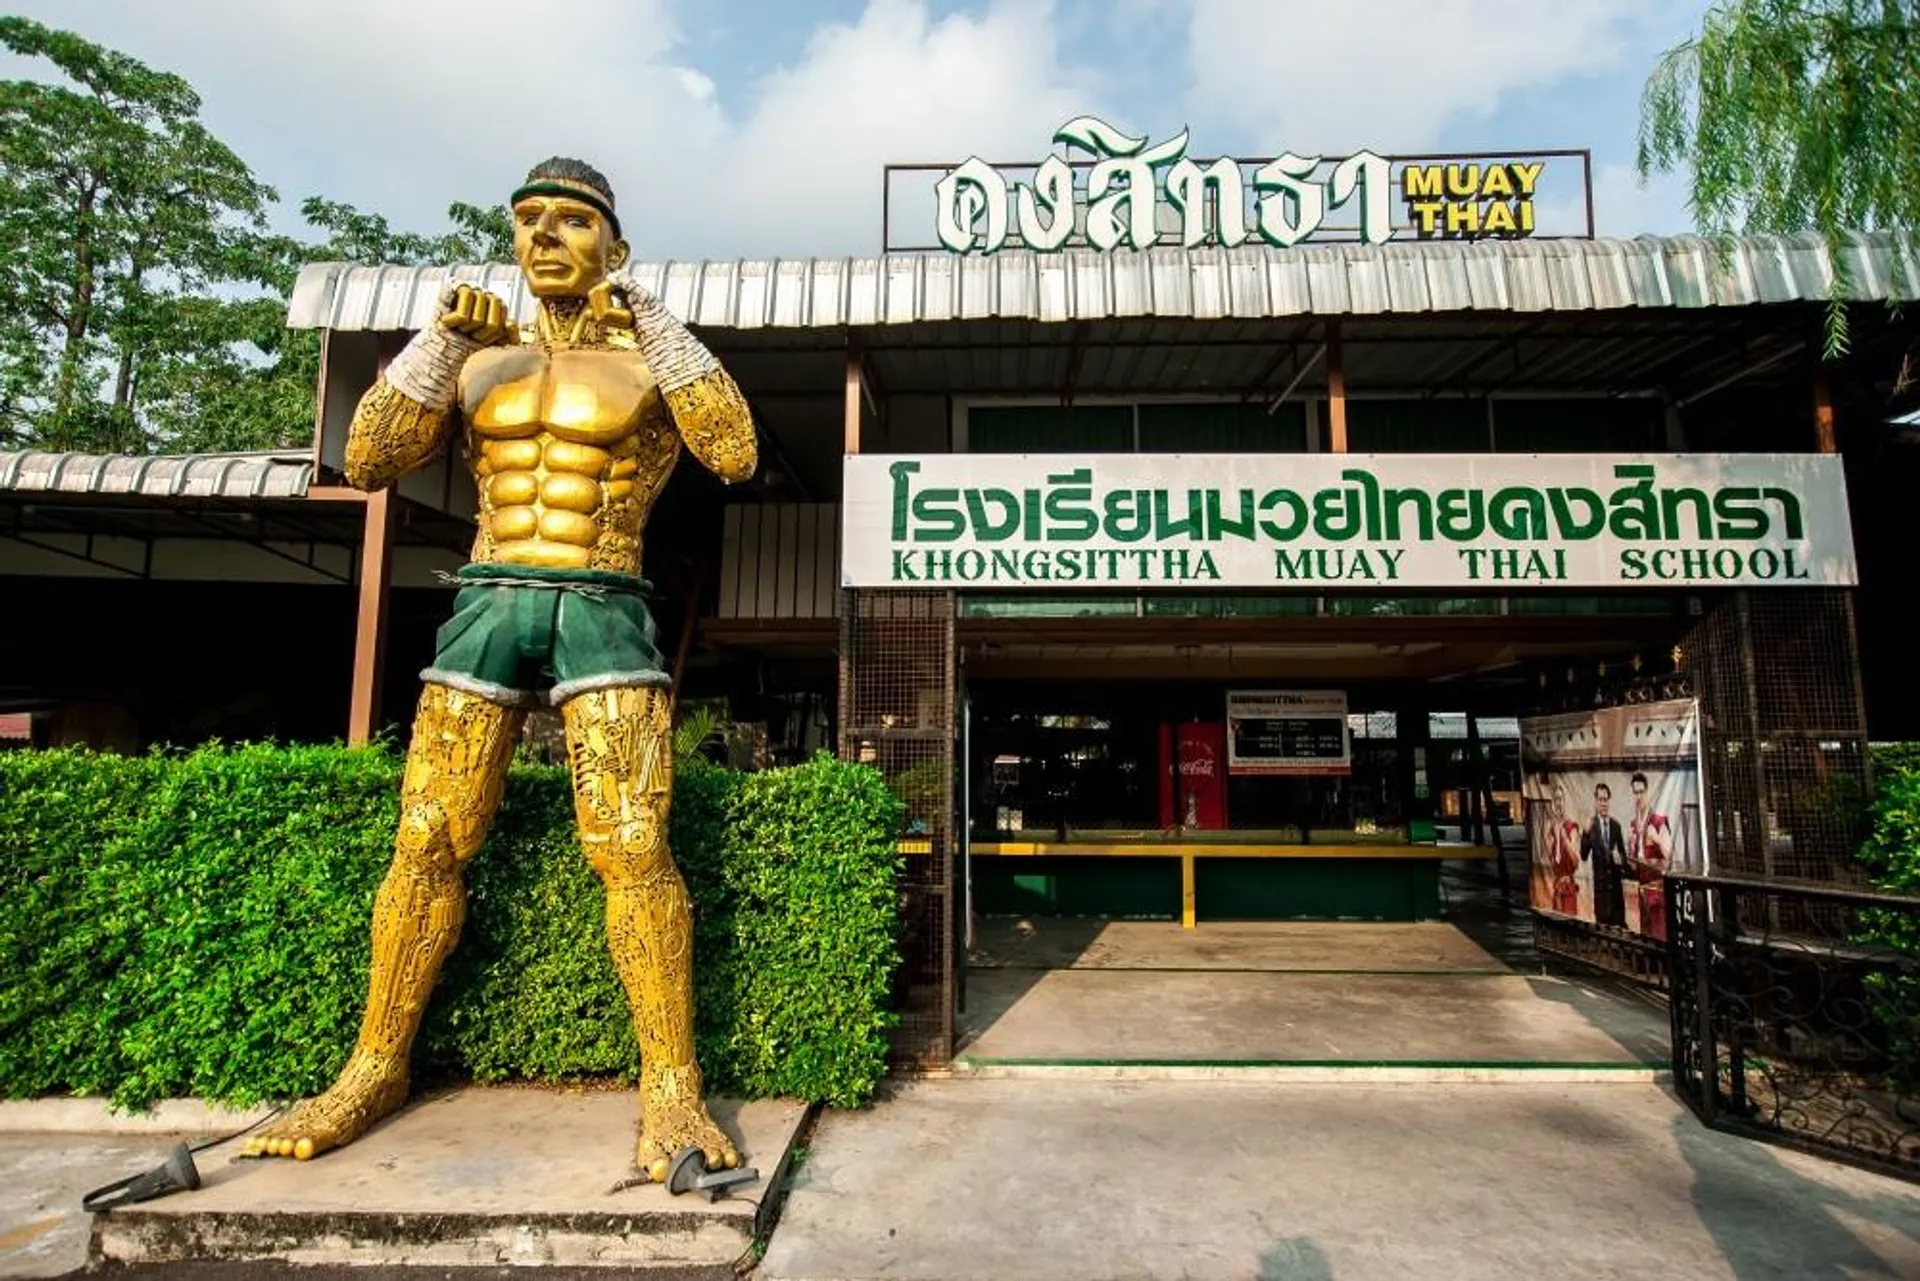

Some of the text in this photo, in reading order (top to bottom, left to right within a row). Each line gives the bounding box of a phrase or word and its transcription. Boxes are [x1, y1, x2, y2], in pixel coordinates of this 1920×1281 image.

[935, 115, 1396, 256] คงสิทธา
[1403, 164, 1543, 200] MUAY
[1409, 202, 1534, 237] THAI
[891, 548, 1810, 581] KHONGSITTHA MUAY THAI SCHOOL
